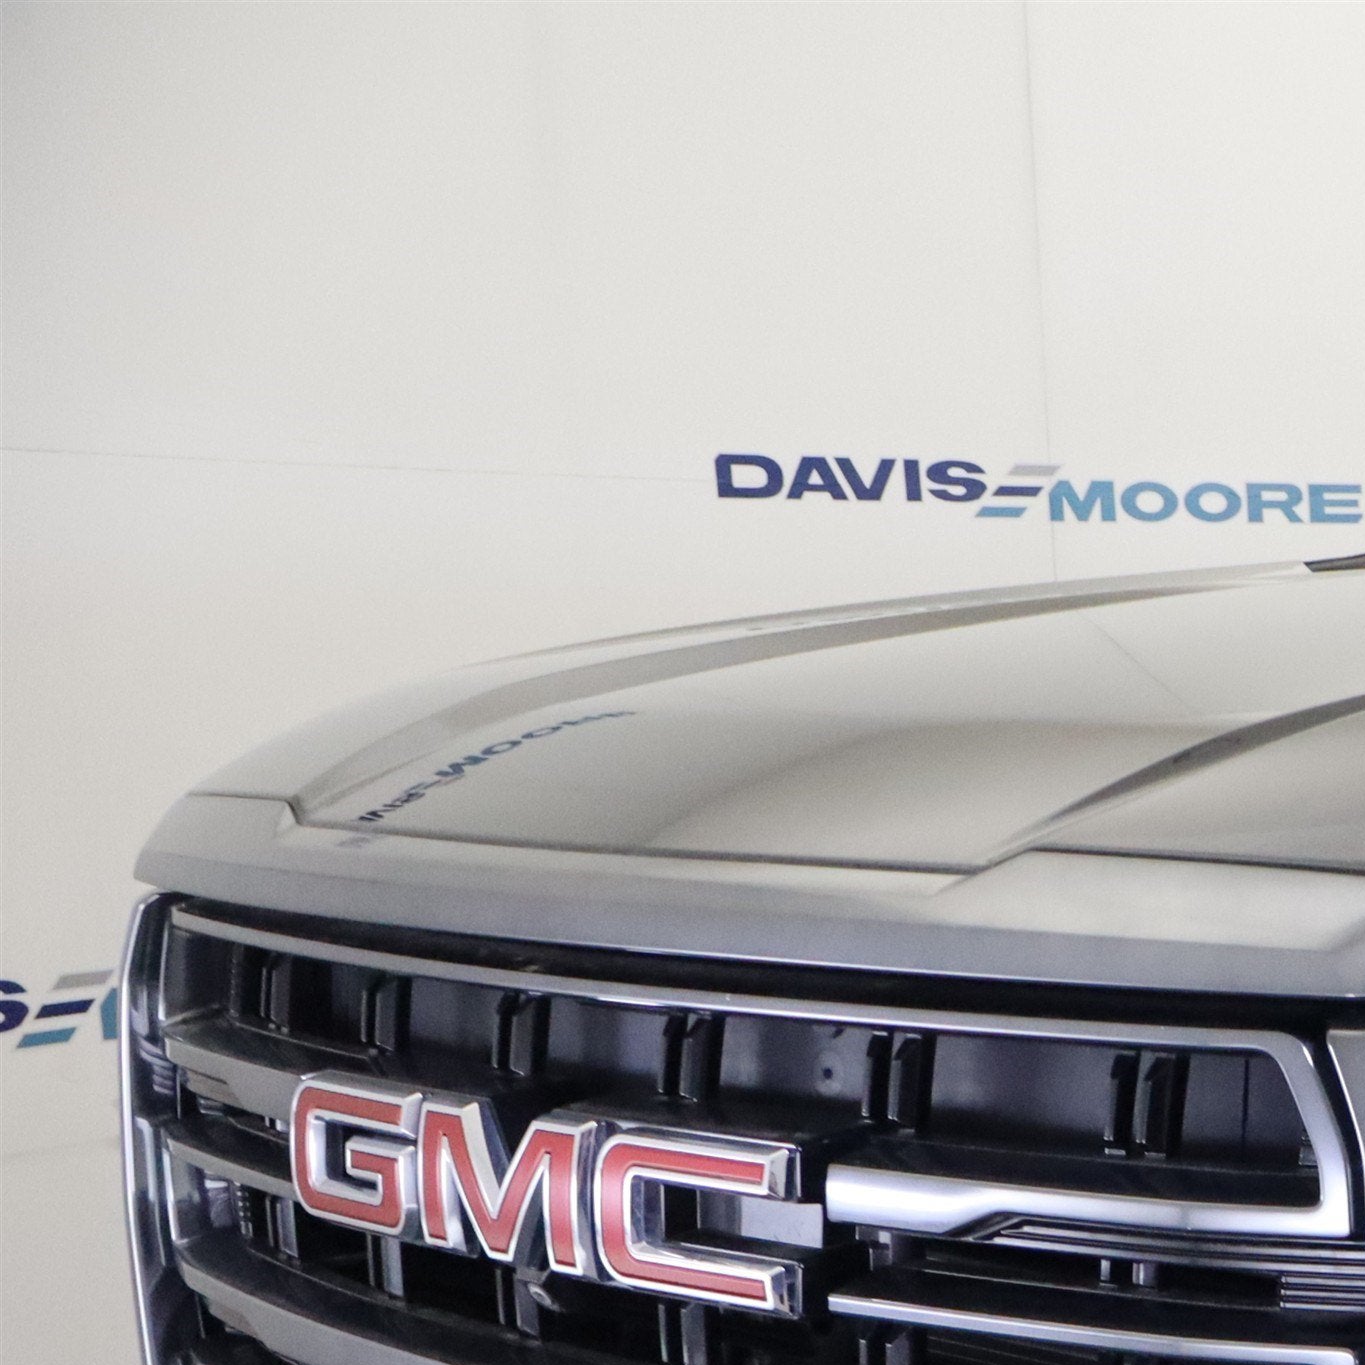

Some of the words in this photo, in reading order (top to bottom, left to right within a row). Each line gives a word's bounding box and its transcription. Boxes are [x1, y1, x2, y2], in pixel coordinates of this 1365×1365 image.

[715, 454, 988, 502] DAVIS
[1048, 480, 1362, 523] MOORE
[290, 1072, 802, 1317] GMC
